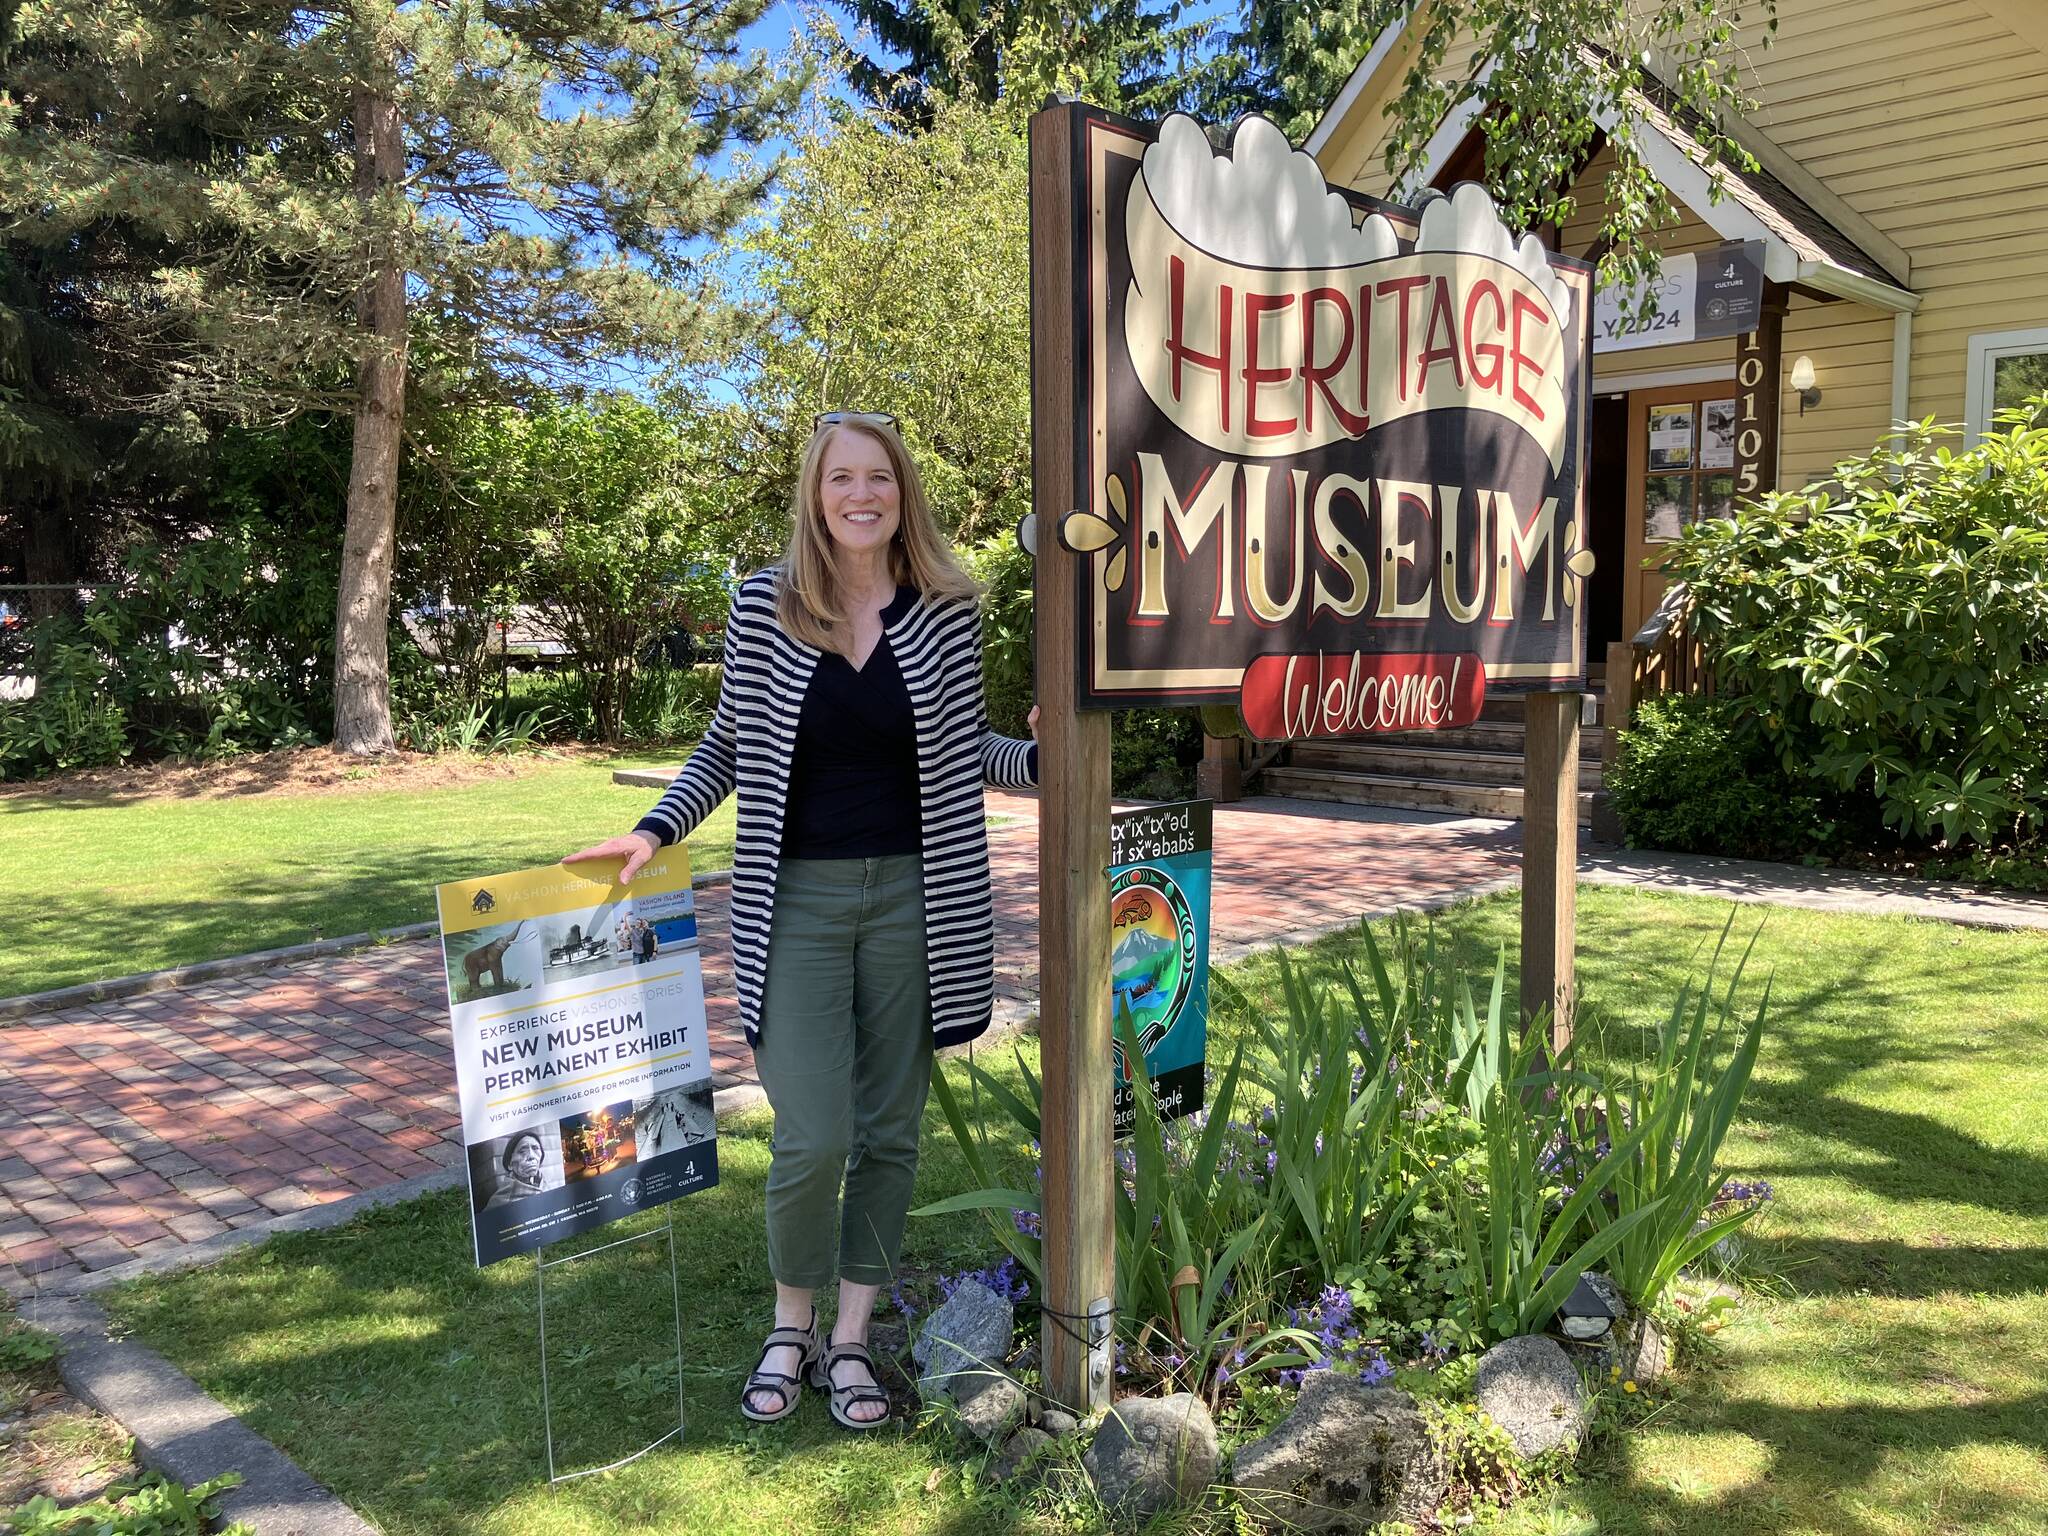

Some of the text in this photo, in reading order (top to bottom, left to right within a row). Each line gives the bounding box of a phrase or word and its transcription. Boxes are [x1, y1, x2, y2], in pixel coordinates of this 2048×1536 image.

[1714, 279, 1744, 289] CULTURE
[1166, 253, 1550, 438] HERITAGE
[1135, 451, 1560, 624] MUSEUM
[1283, 648, 1462, 739] Welcome!
[504, 885, 559, 903] VASHON
[562, 874, 613, 893] HERITAGE
[639, 896, 662, 906] VASHON
[663, 892, 685, 902] ISLAND
[480, 983, 684, 1040] EXPERIENCE VASHON STORIES
[482, 1011, 643, 1068] NEW MUSEUM
[485, 1026, 688, 1094] PERMANENT EXHIBIT
[489, 1061, 691, 1122] VISIT VASHONHERITAGE.ORG FOR MORE INFORMATION
[1112, 1108, 1137, 1126] ater
[678, 1174, 704, 1187] CULTURE
[684, 1160, 695, 1175] 4
